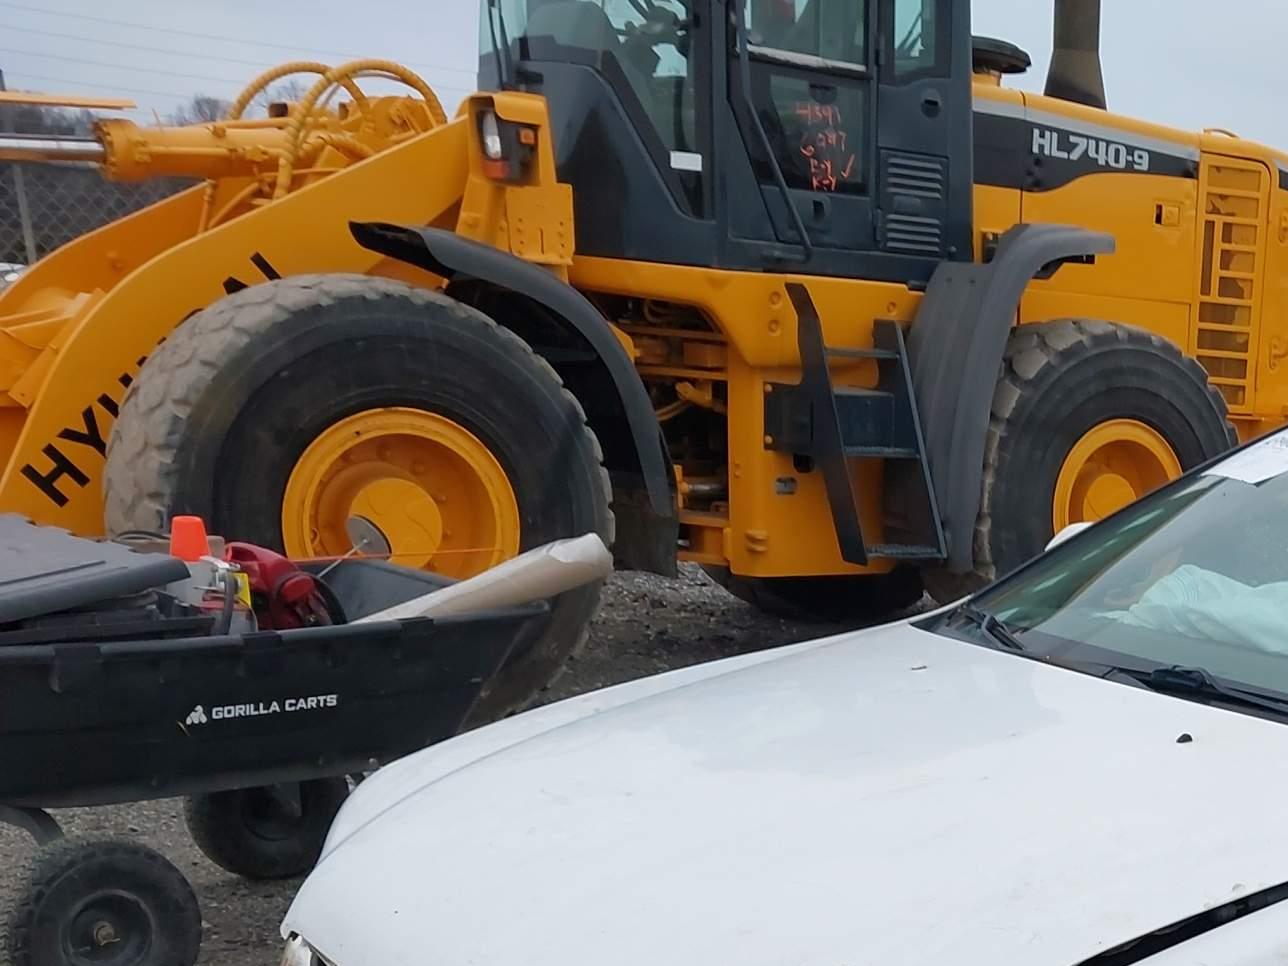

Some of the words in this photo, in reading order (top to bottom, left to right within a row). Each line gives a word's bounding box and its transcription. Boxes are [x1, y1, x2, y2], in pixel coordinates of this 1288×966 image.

[1032, 127, 1150, 171] HL740-9
[211, 701, 281, 720] GORILLA
[284, 694, 338, 711] CARTS
